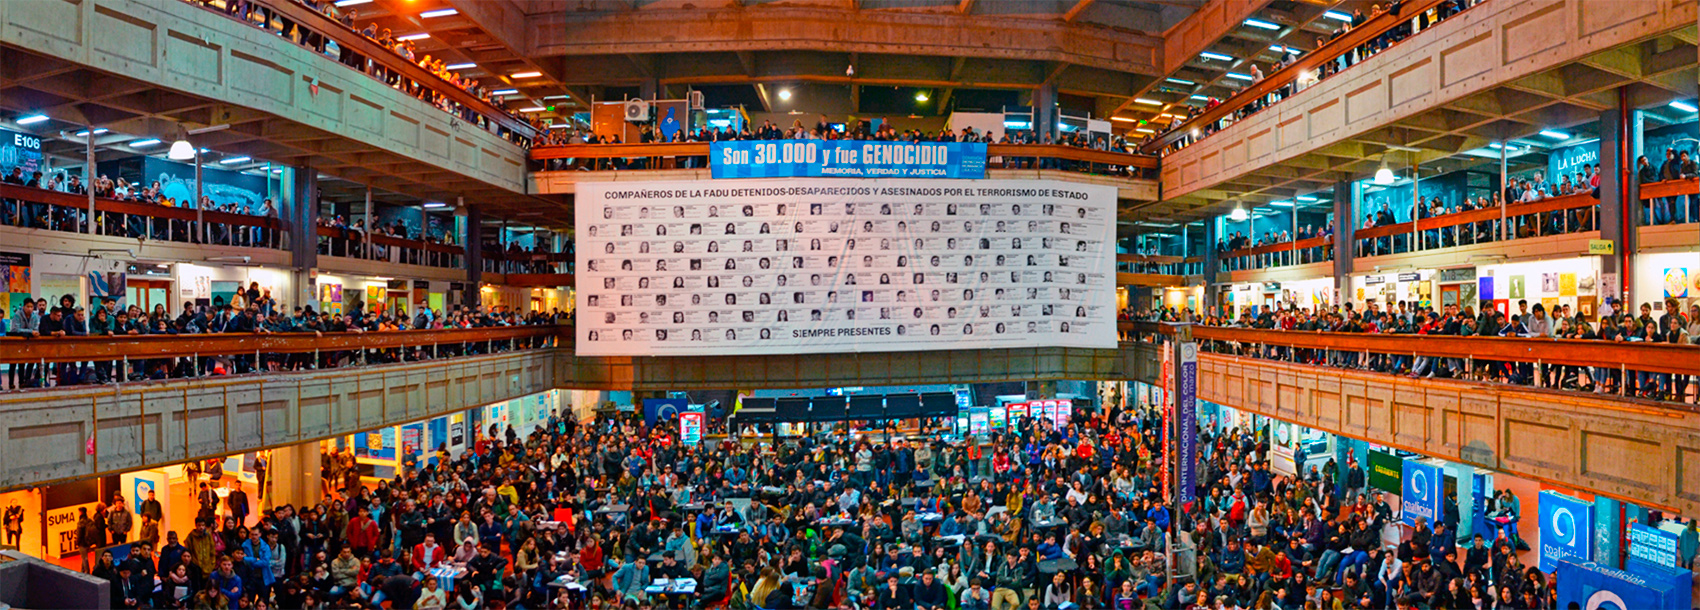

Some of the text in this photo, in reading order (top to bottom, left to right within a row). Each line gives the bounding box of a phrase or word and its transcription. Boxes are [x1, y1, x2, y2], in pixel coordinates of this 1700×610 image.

[14, 133, 41, 150] E106
[723, 147, 749, 165] Son
[755, 143, 817, 164] 30.000
[821, 149, 831, 167] y
[835, 146, 858, 164] fue
[862, 144, 948, 165] GENOCIDIO
[1557, 150, 1597, 171] LA LUCHA
[821, 167, 864, 176] MEMORIA,
[604, 187, 1089, 200] COMPAÑEROS DE LA FADU DETENIDOS-DESAPARECIDOS Y ASESINADOS POR EL TERRORISMO DE ESTADO
[792, 328, 836, 338] SIEMPRE
[837, 327, 891, 337] PRESENTES
[1188, 395, 1194, 407] de
[1181, 416, 1189, 486] INTERNACIONAL
[48, 511, 75, 526] SUMA
[1595, 566, 1646, 586] coalición
